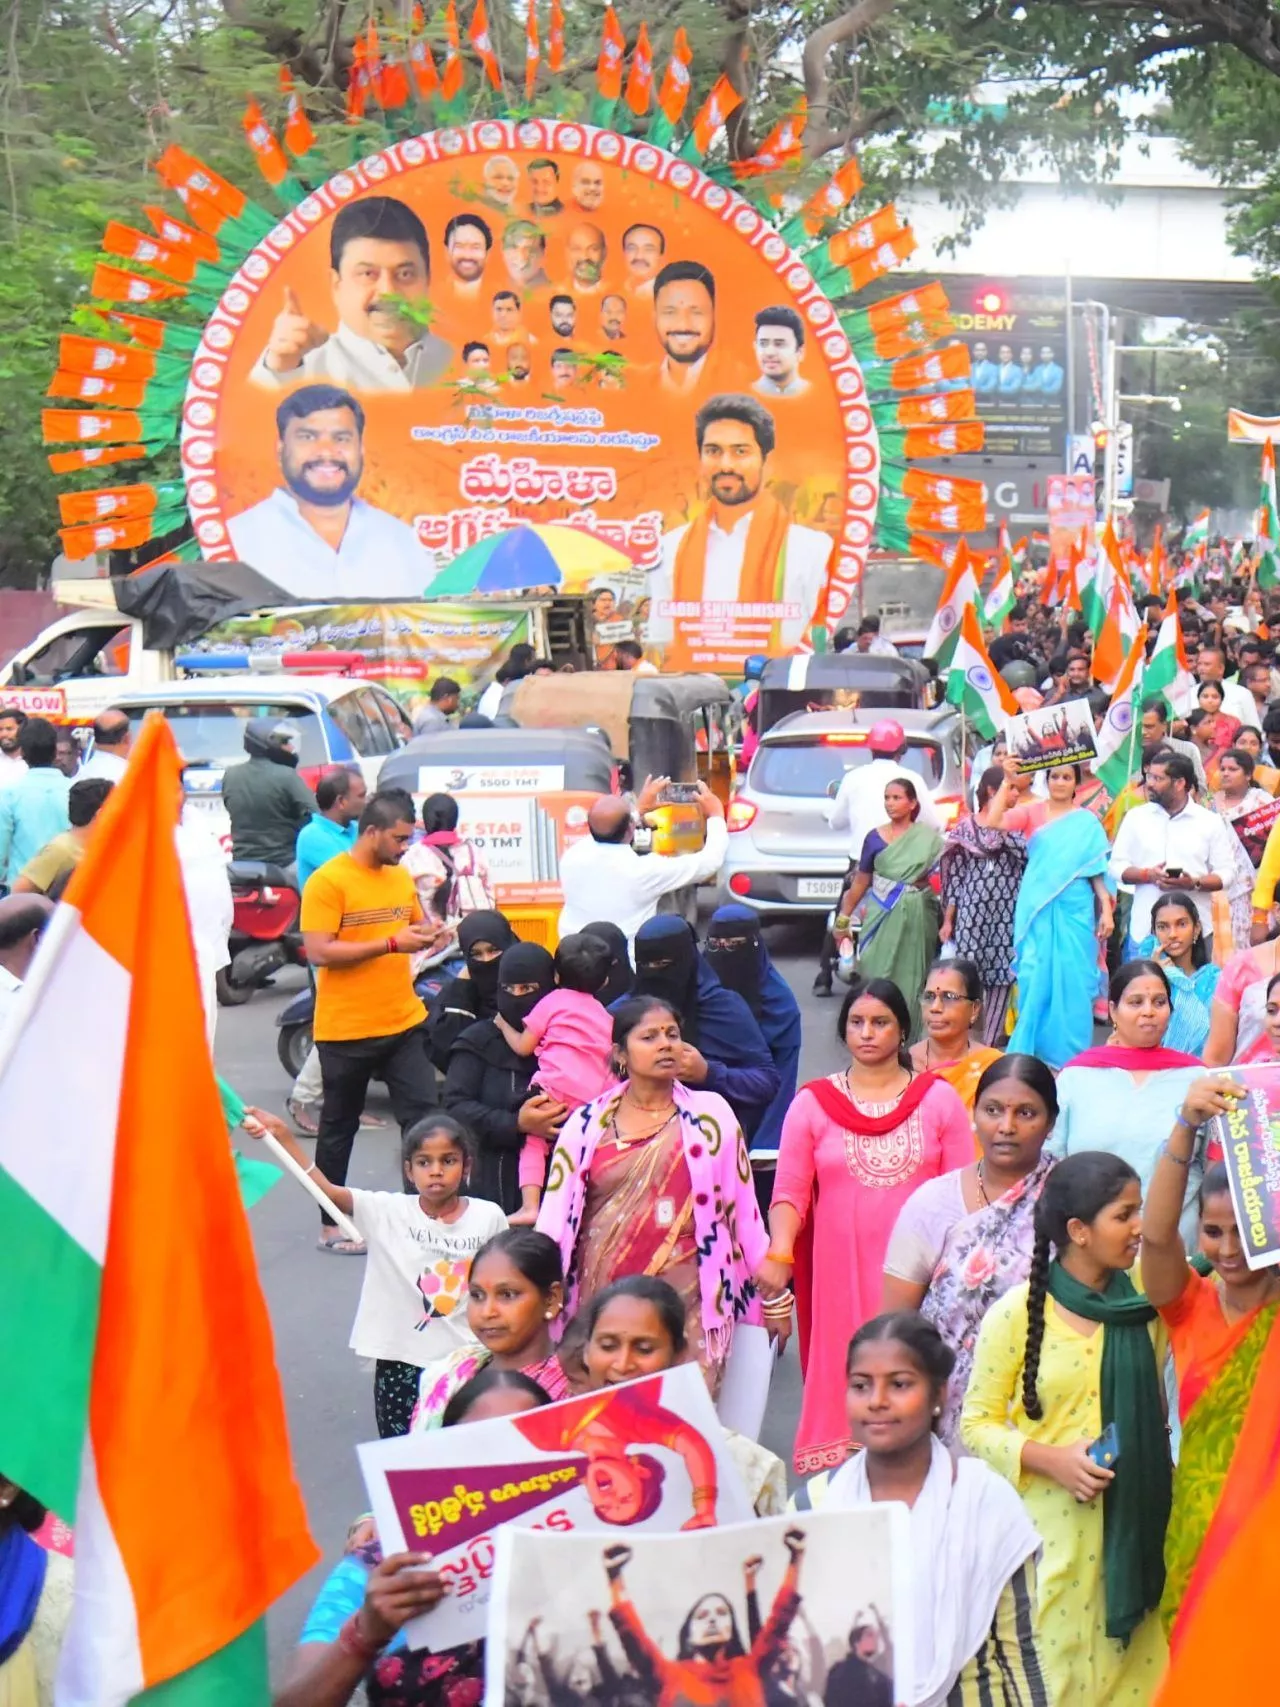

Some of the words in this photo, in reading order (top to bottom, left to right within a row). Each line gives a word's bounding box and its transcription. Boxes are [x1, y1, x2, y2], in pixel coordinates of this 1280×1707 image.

[955, 314, 1018, 331] DEMY
[461, 454, 616, 505] మహిళా
[480, 822, 522, 835] STAR
[491, 836, 523, 848] TMT
[806, 881, 841, 894] TS09F
[1234, 1140, 1268, 1248] రాజకీయాలు
[489, 1466, 578, 1503] మహిళా
[408, 1483, 487, 1537] వ్యతిరేకి
